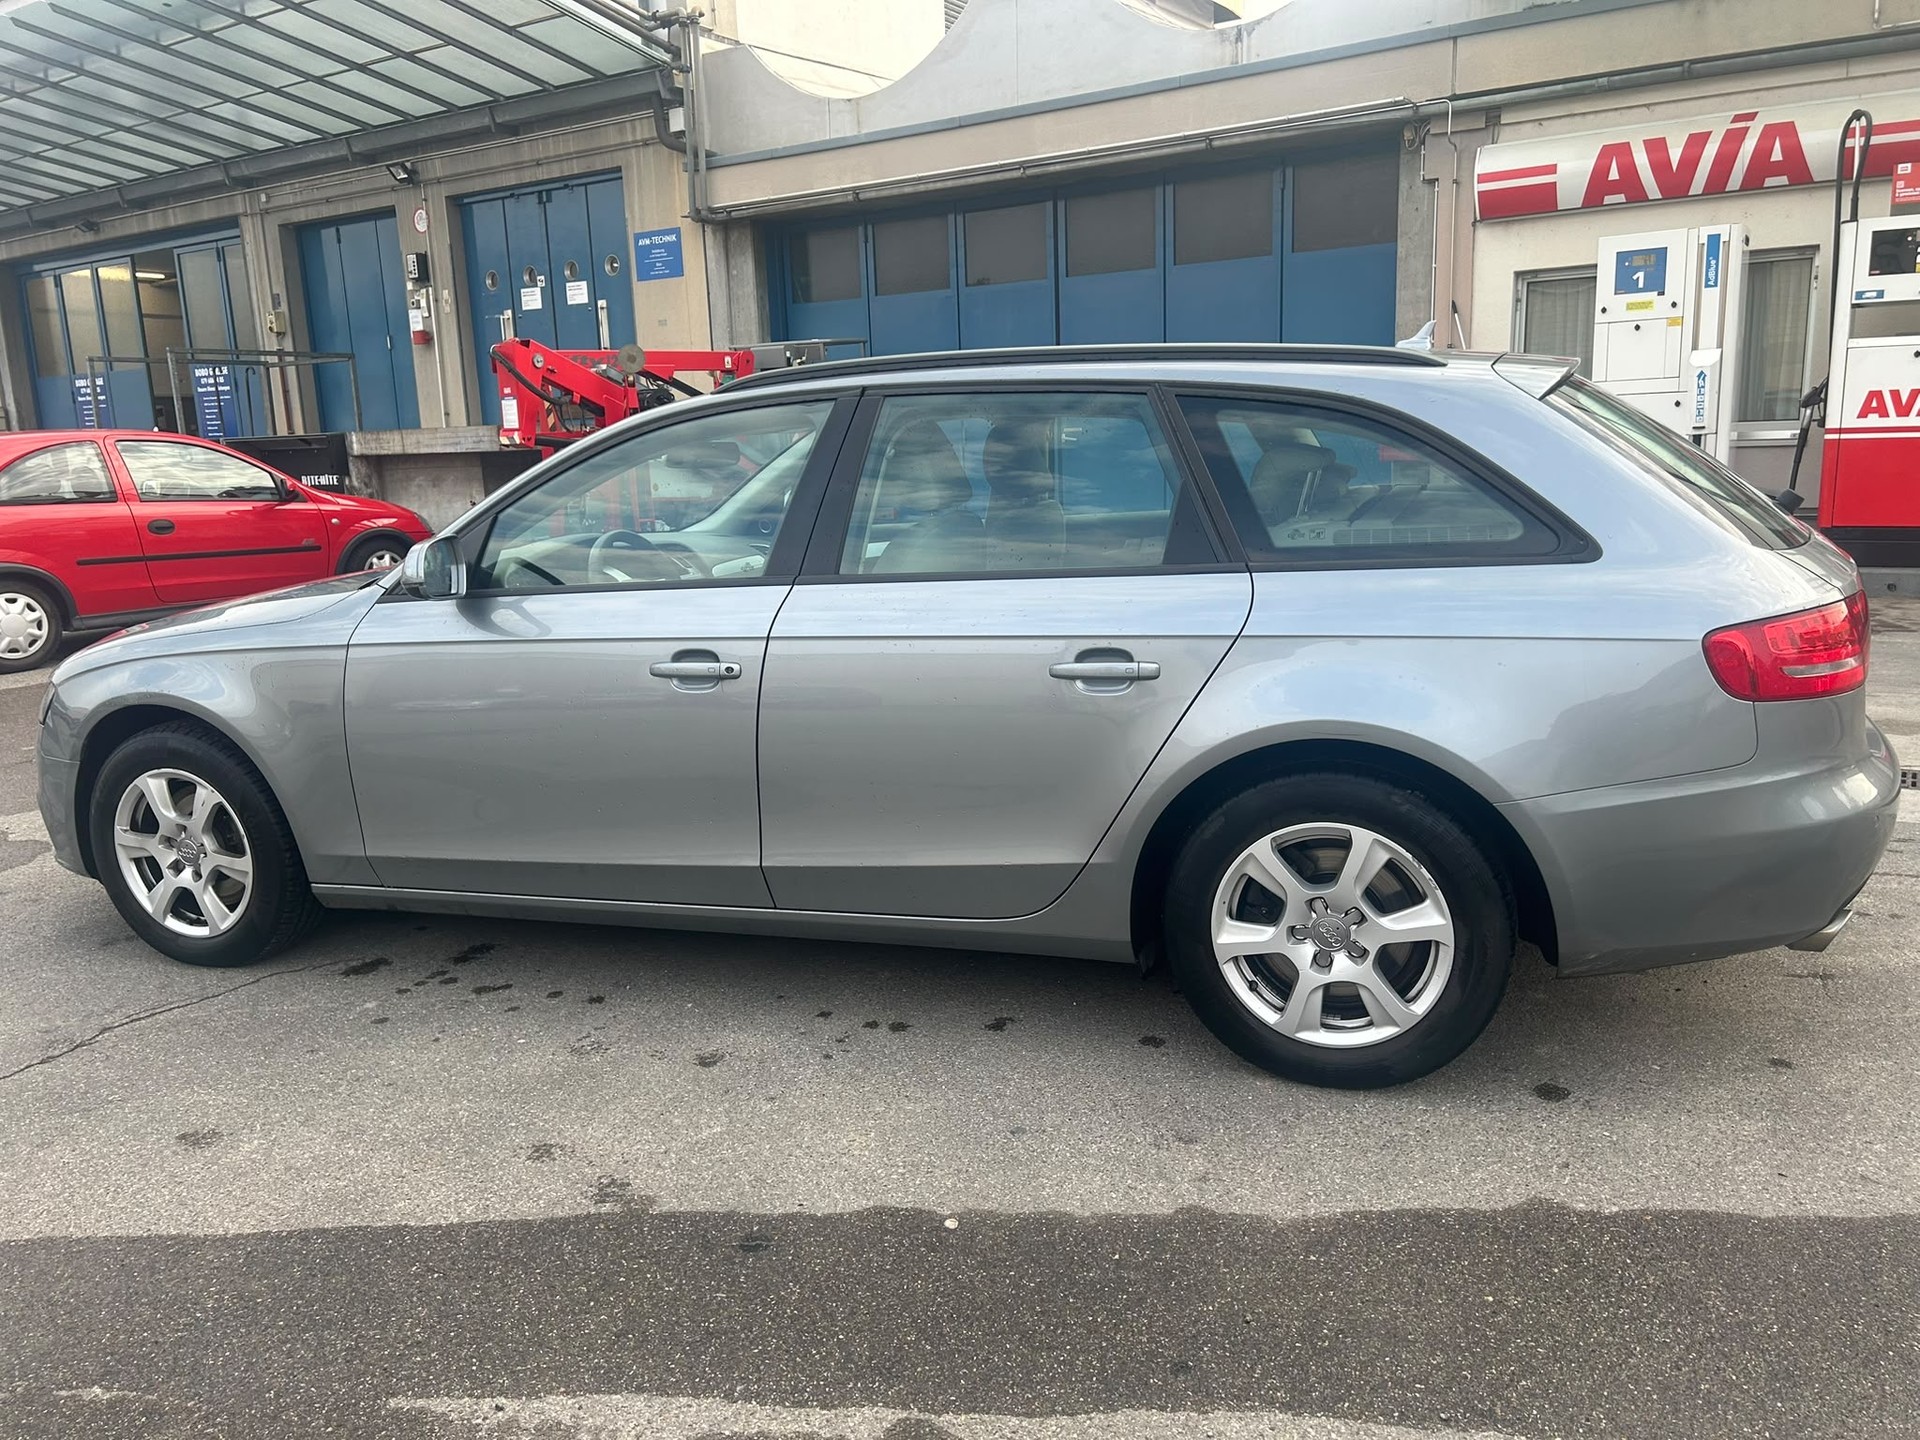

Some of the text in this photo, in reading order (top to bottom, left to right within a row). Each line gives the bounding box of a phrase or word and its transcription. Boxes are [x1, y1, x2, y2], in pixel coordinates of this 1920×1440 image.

[1581, 111, 1814, 208] AVIA
[638, 233, 677, 247] AVM-TECHNIK
[1632, 271, 1645, 289] 1
[1856, 388, 1920, 419] AV
